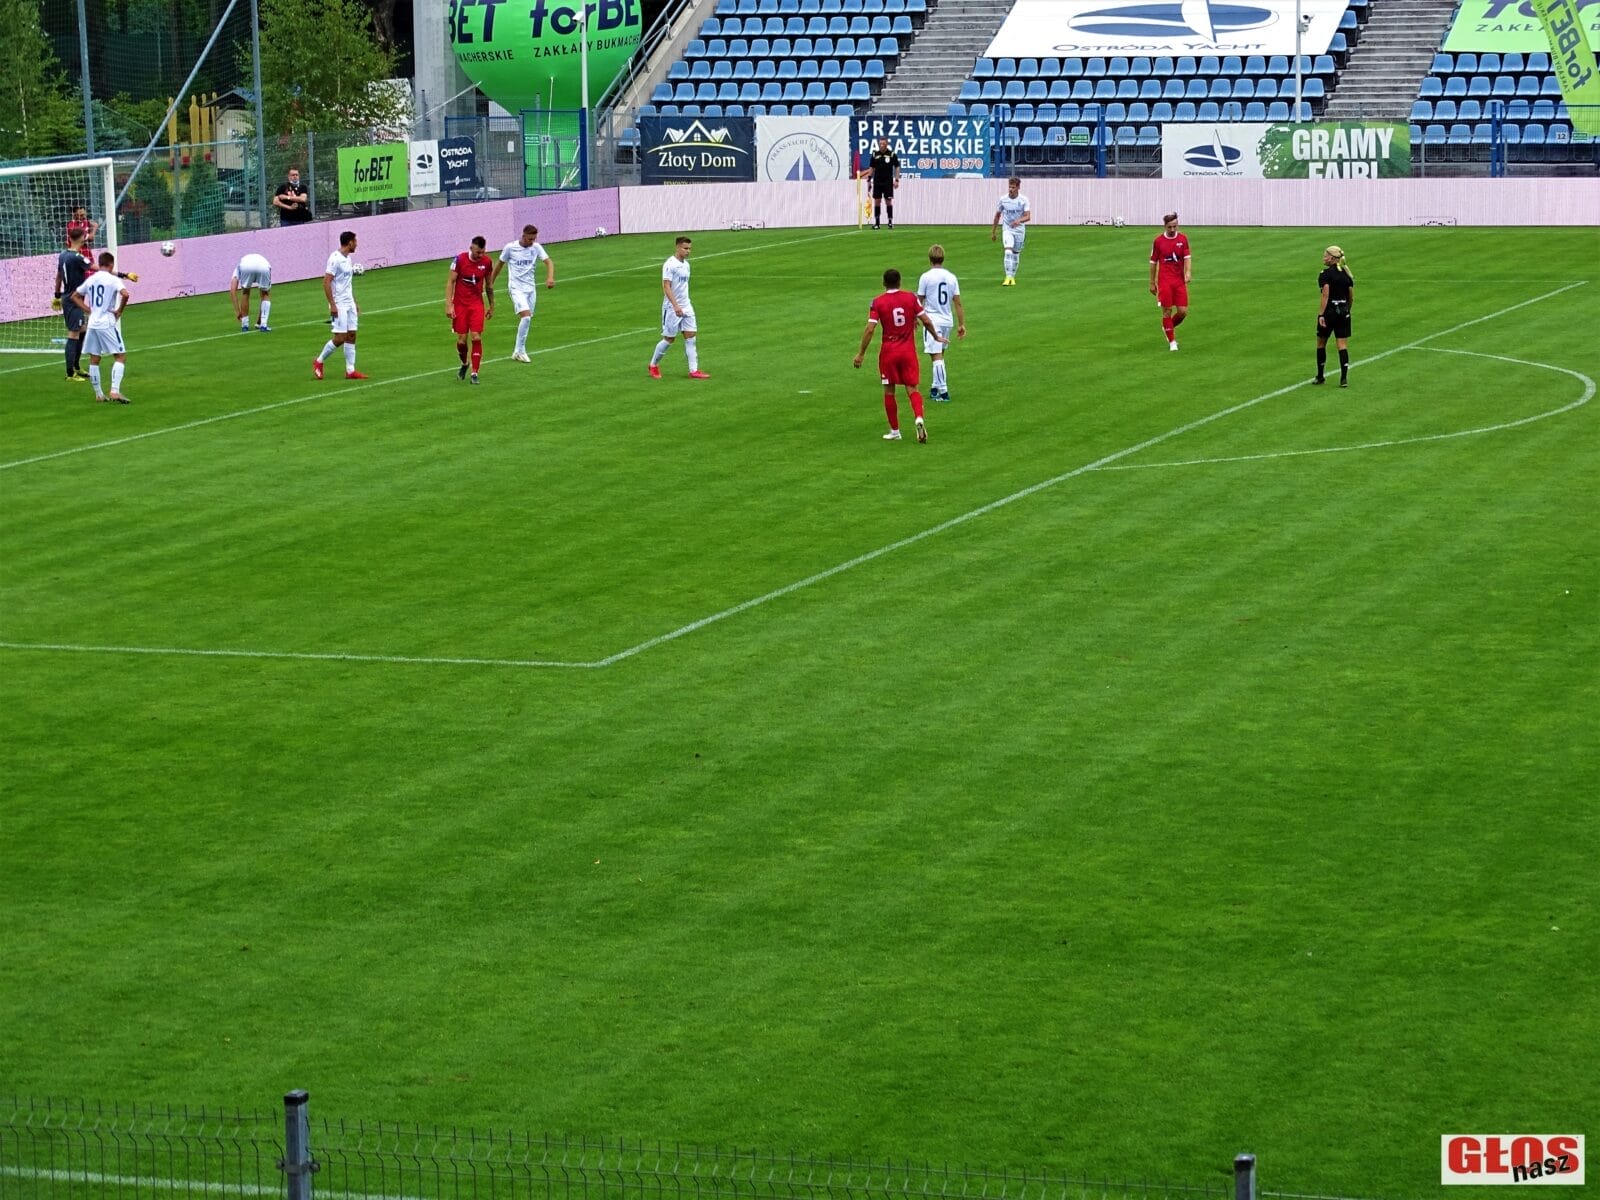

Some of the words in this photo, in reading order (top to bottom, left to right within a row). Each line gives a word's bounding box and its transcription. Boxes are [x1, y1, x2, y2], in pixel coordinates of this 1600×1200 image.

[1292, 128, 1394, 160] GRAMY
[353, 155, 393, 184] forBET
[446, 159, 468, 170] YACHT
[658, 152, 697, 171] Złoty
[701, 156, 736, 168] Dom
[917, 157, 938, 169] 691
[962, 157, 984, 169] 570
[88, 284, 105, 308] 18
[937, 281, 949, 306] 6
[892, 307, 906, 327] 6
